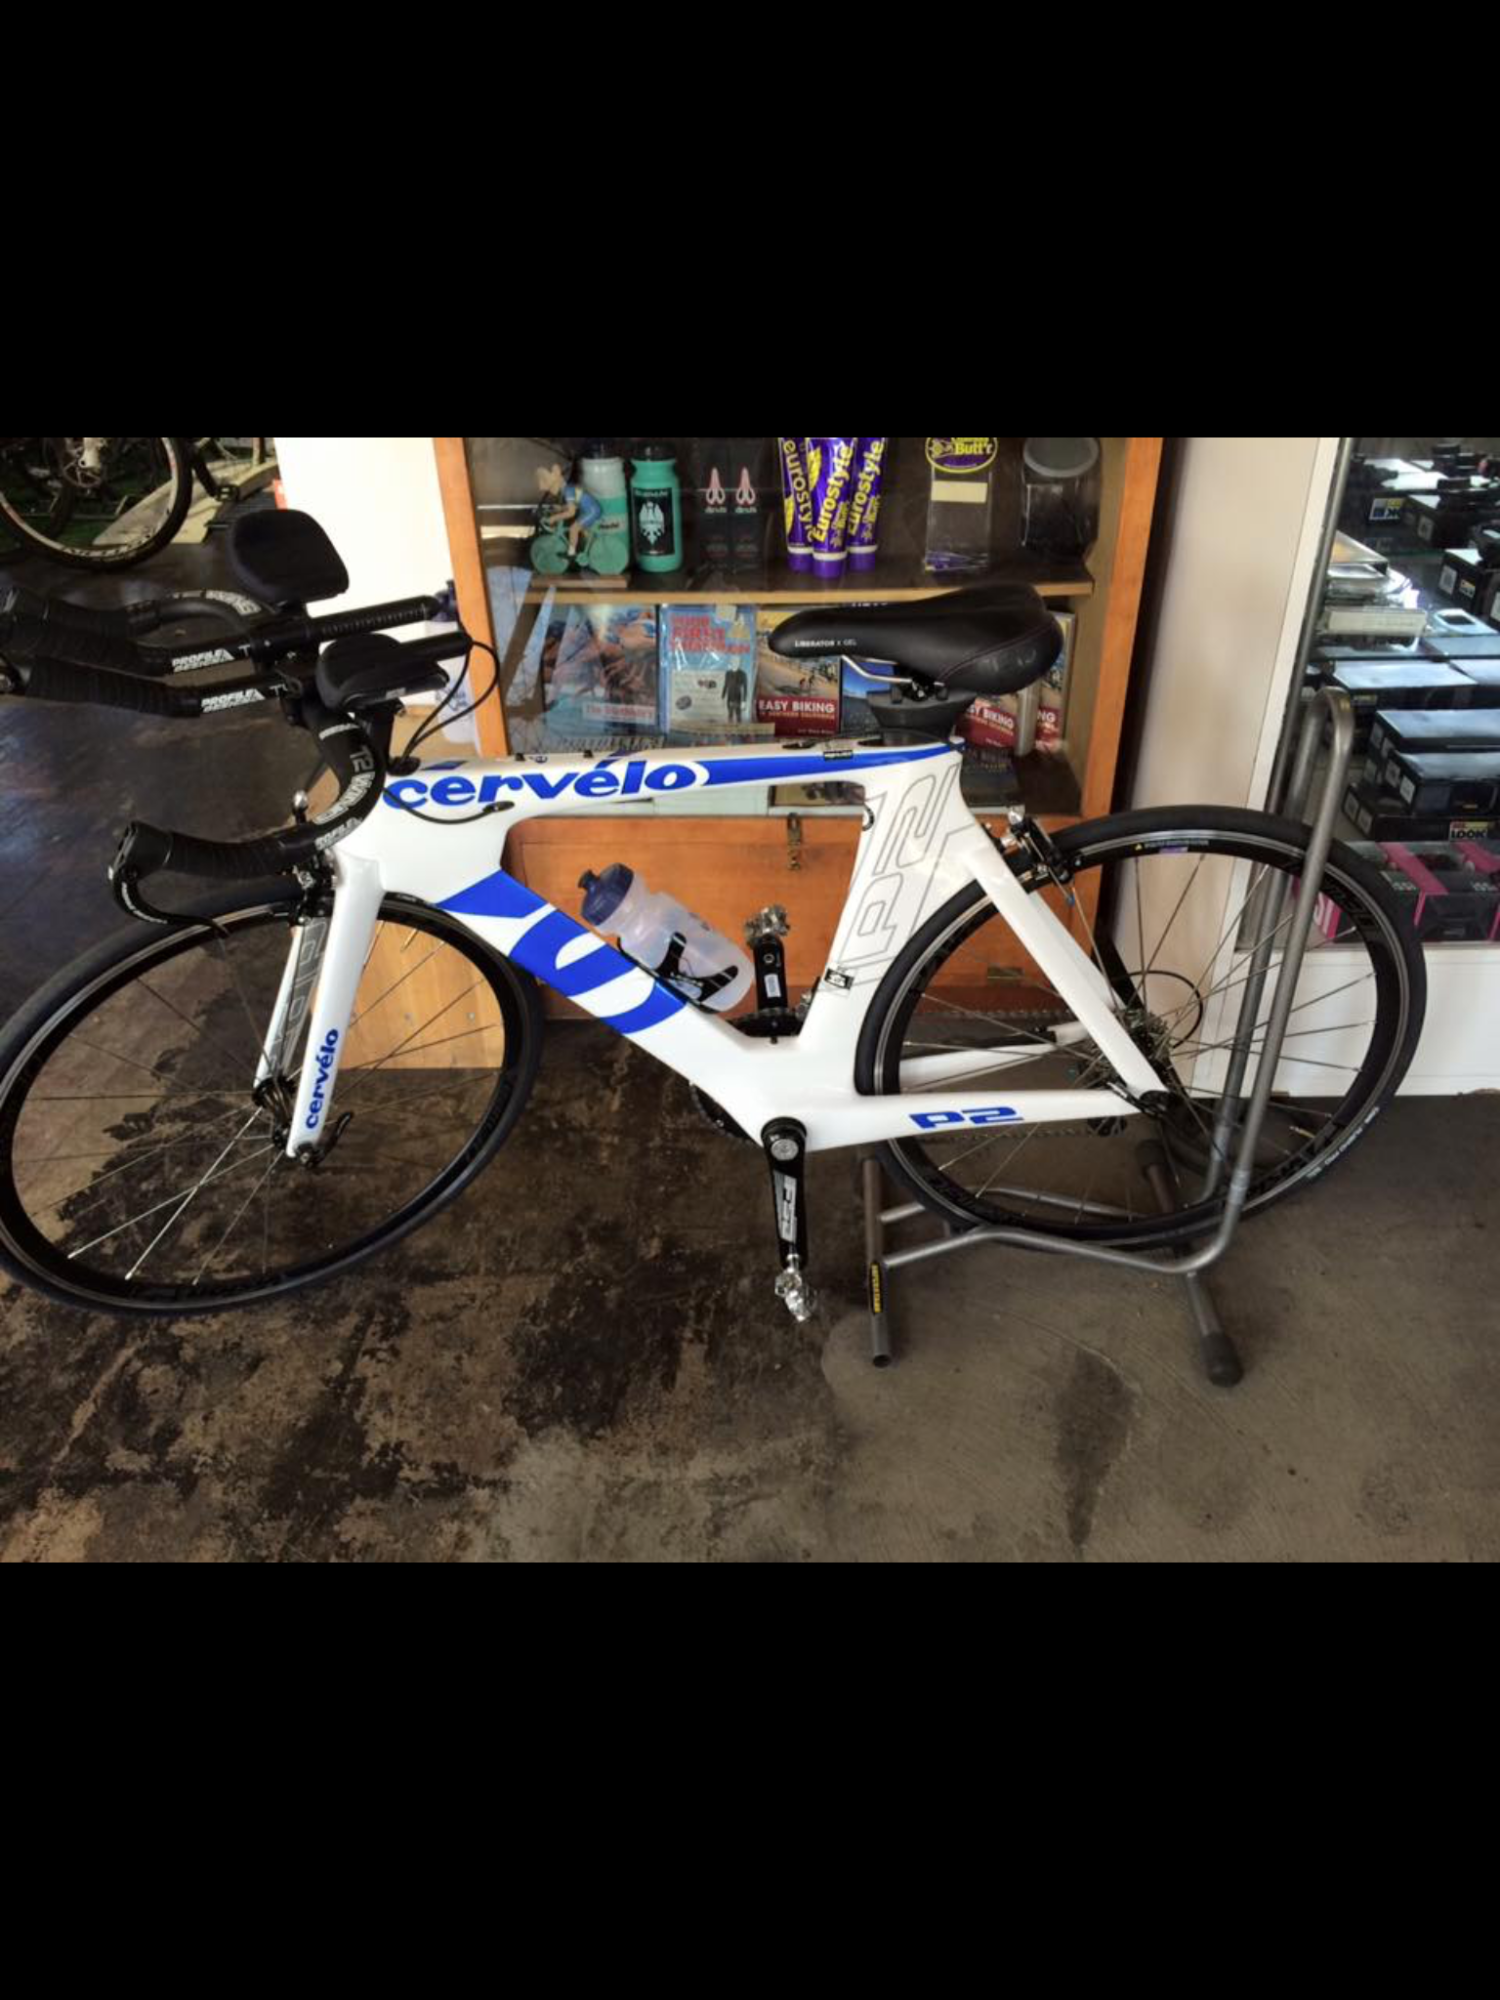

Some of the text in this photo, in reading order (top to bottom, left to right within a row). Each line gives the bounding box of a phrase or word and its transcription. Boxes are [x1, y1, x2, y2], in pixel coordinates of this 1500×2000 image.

[813, 443, 853, 542] Eurostyle
[758, 699, 835, 713] EASY BIKING
[383, 752, 697, 810] cervélo
[305, 1028, 339, 1129] cervélo
[908, 1106, 1024, 1129] P2
